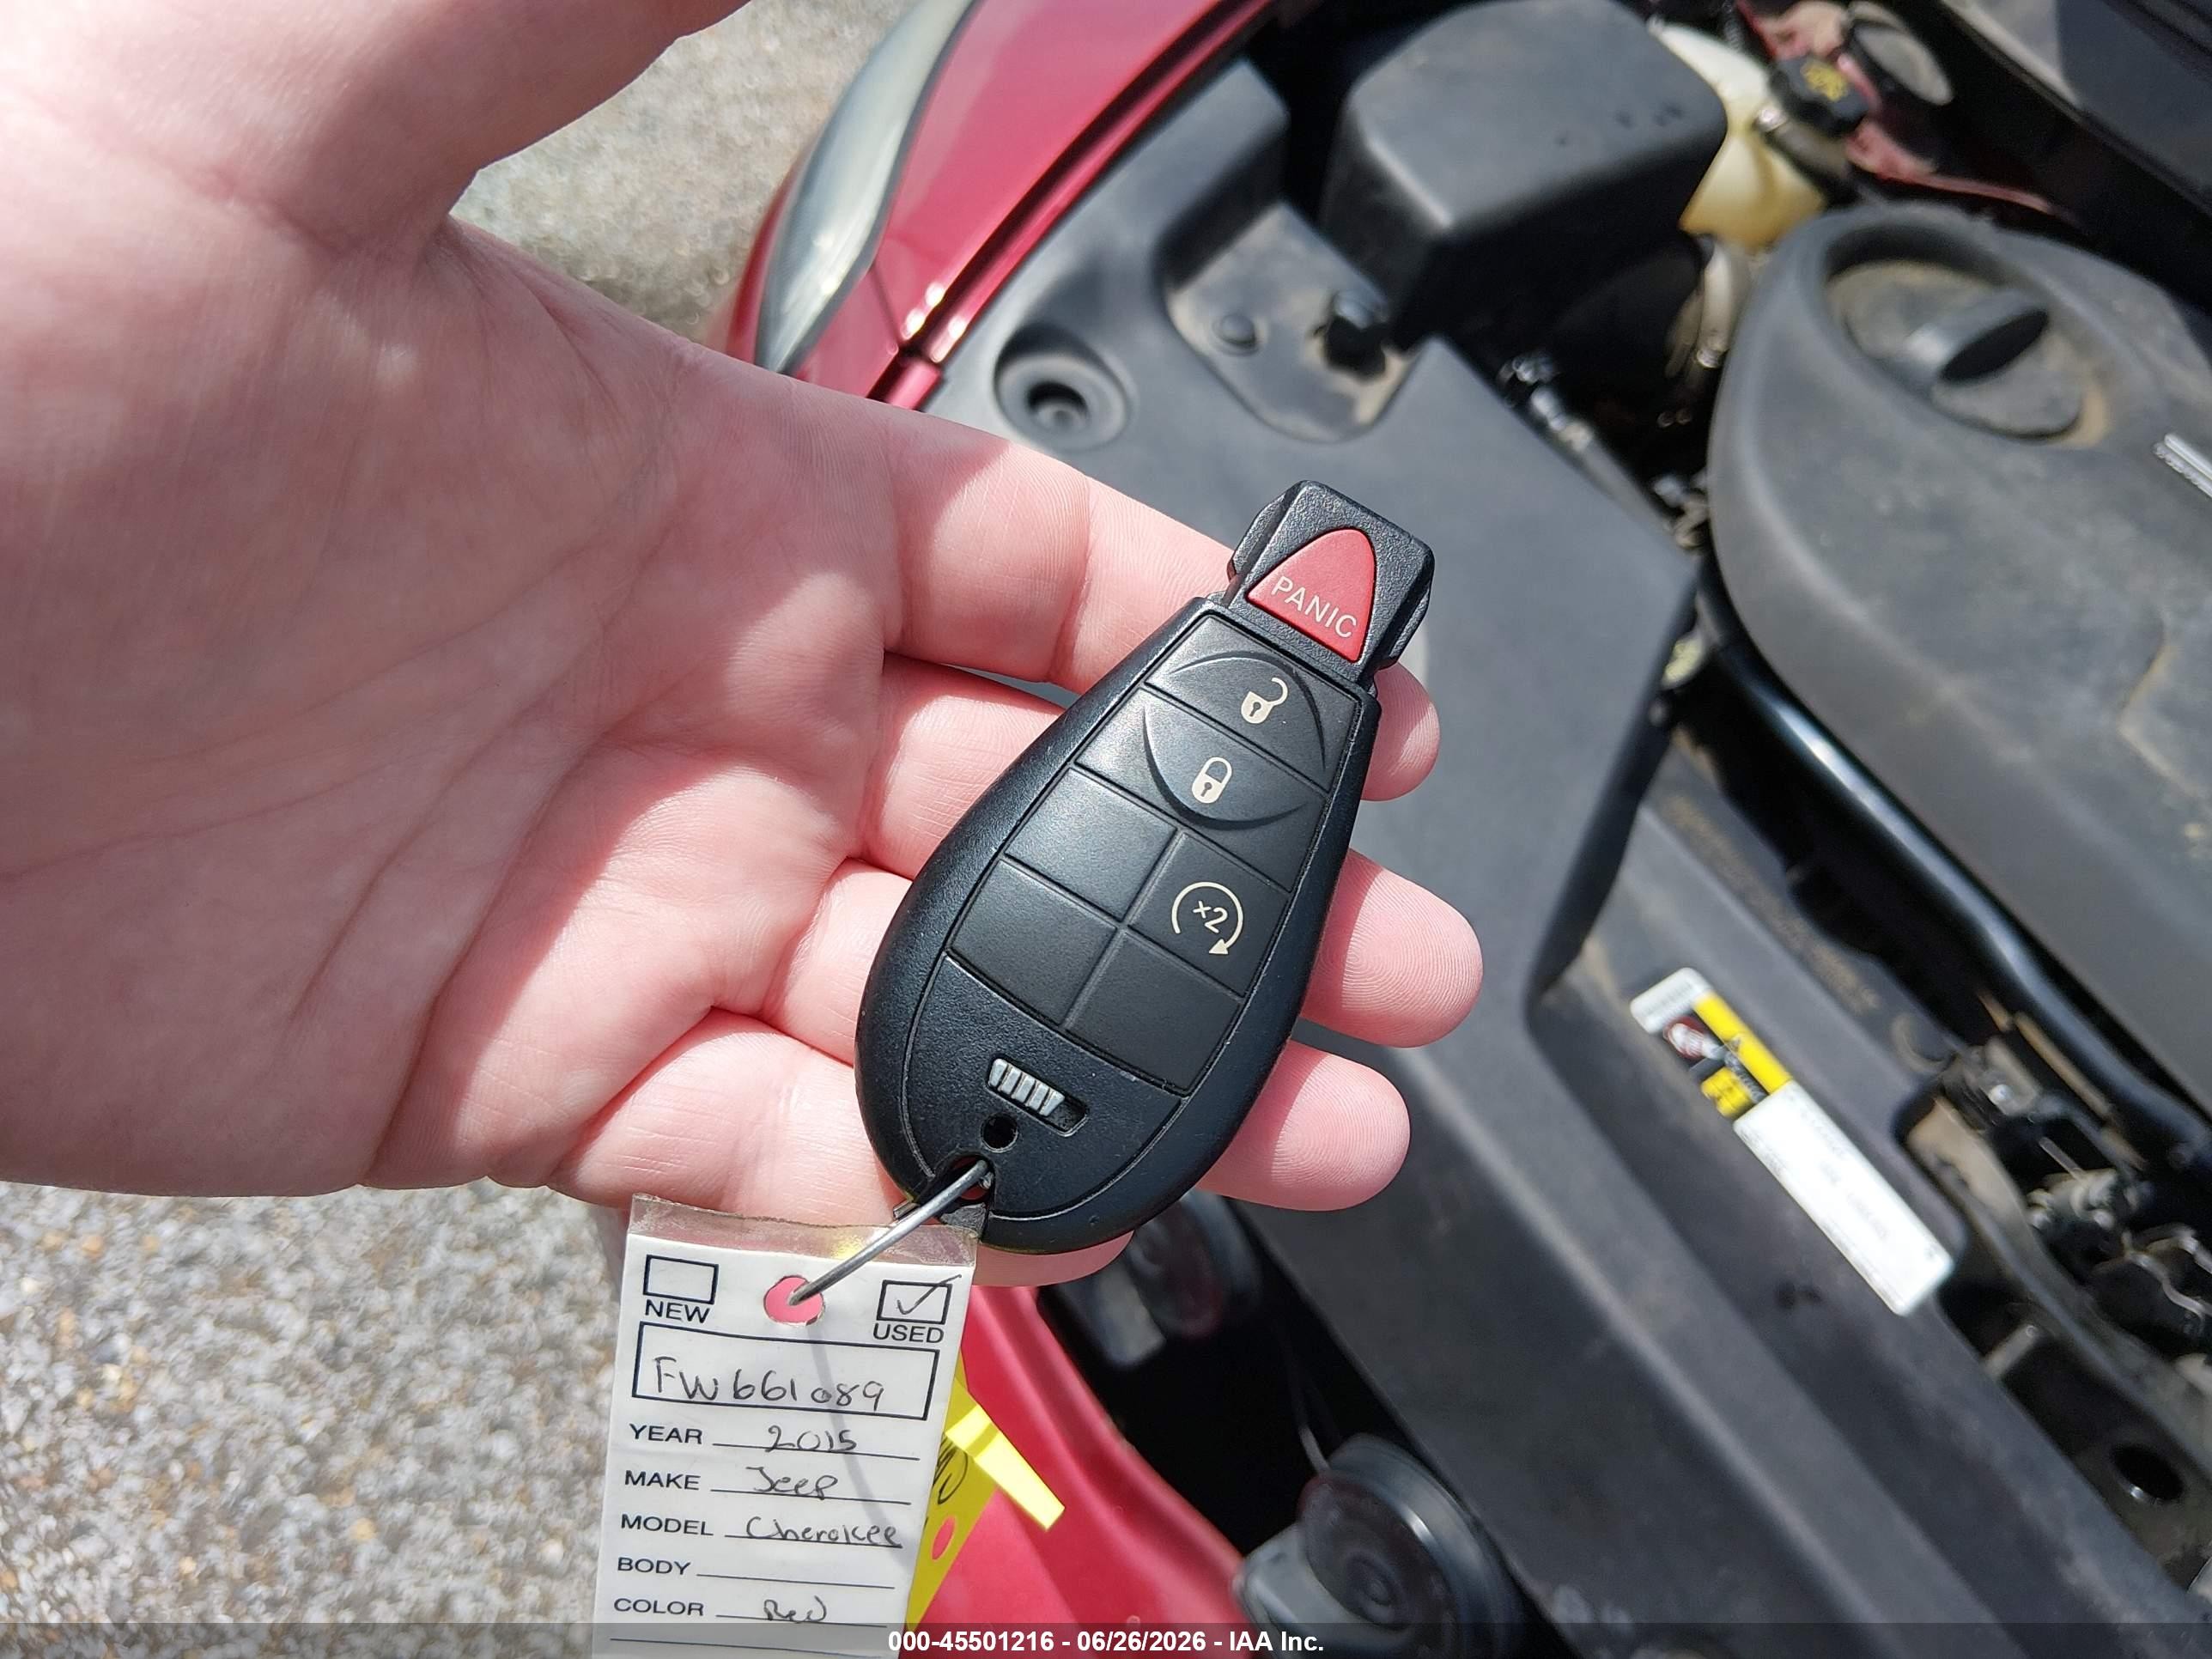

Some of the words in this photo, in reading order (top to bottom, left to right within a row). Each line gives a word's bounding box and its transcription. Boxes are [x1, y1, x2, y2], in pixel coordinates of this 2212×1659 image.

[1271, 574, 1358, 640] PANIC
[644, 1299, 711, 1324] NEW
[872, 1322, 945, 1345] USED
[629, 1423, 703, 1445] YEAR
[765, 1425, 857, 1453] 2015
[623, 1469, 702, 1492] MAKE
[620, 1513, 714, 1536] MODEL
[745, 1516, 904, 1547] Cherokee
[617, 1556, 692, 1577] BODY
[613, 1597, 705, 1617] COLOR
